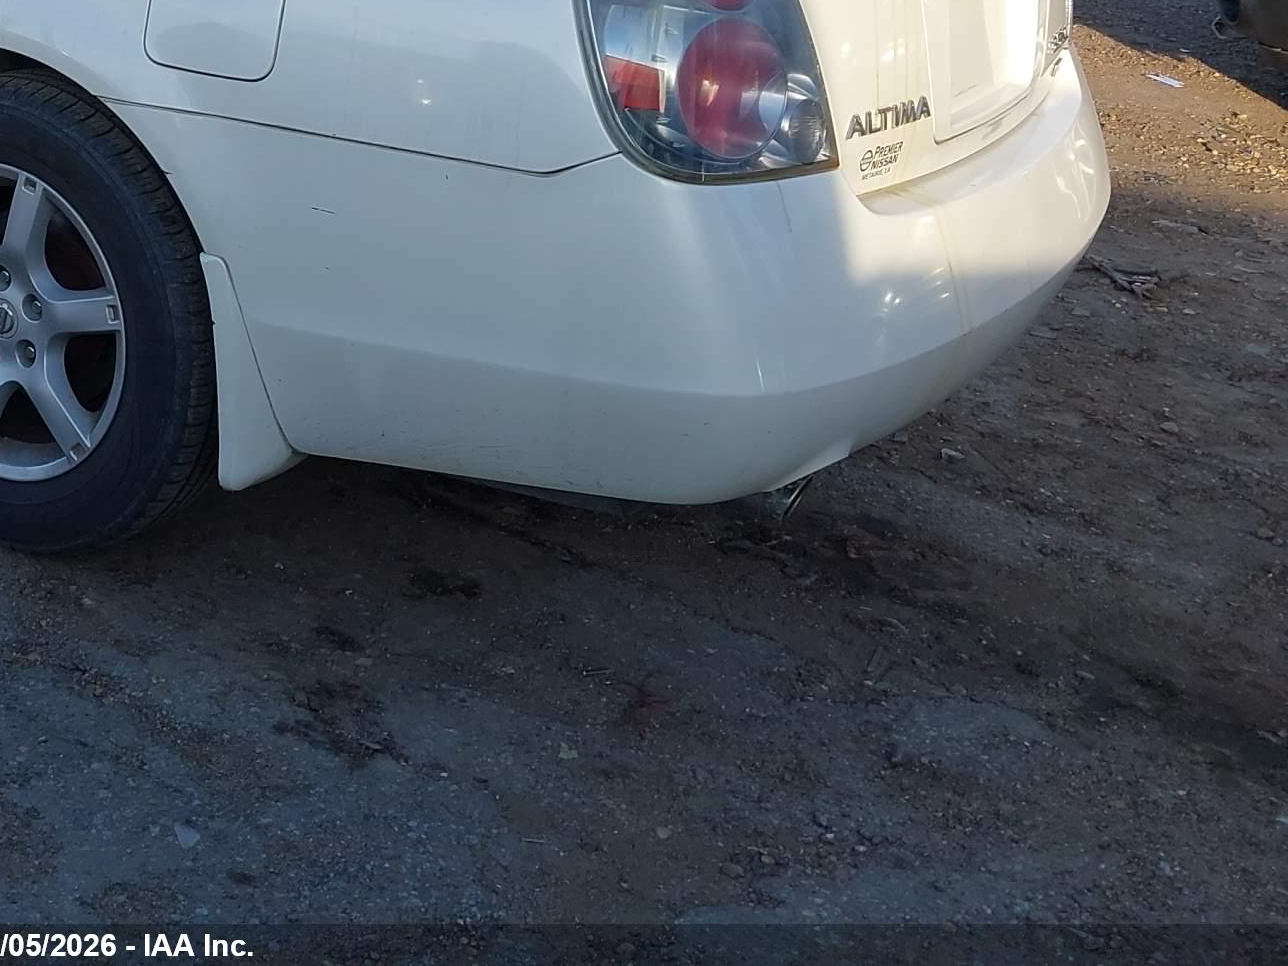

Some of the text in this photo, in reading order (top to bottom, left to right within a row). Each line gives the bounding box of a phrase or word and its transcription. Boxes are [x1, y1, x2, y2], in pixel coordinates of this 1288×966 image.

[846, 95, 932, 141] ALTIMA
[872, 141, 904, 159] PREMIER
[871, 154, 899, 170] NISSAN
